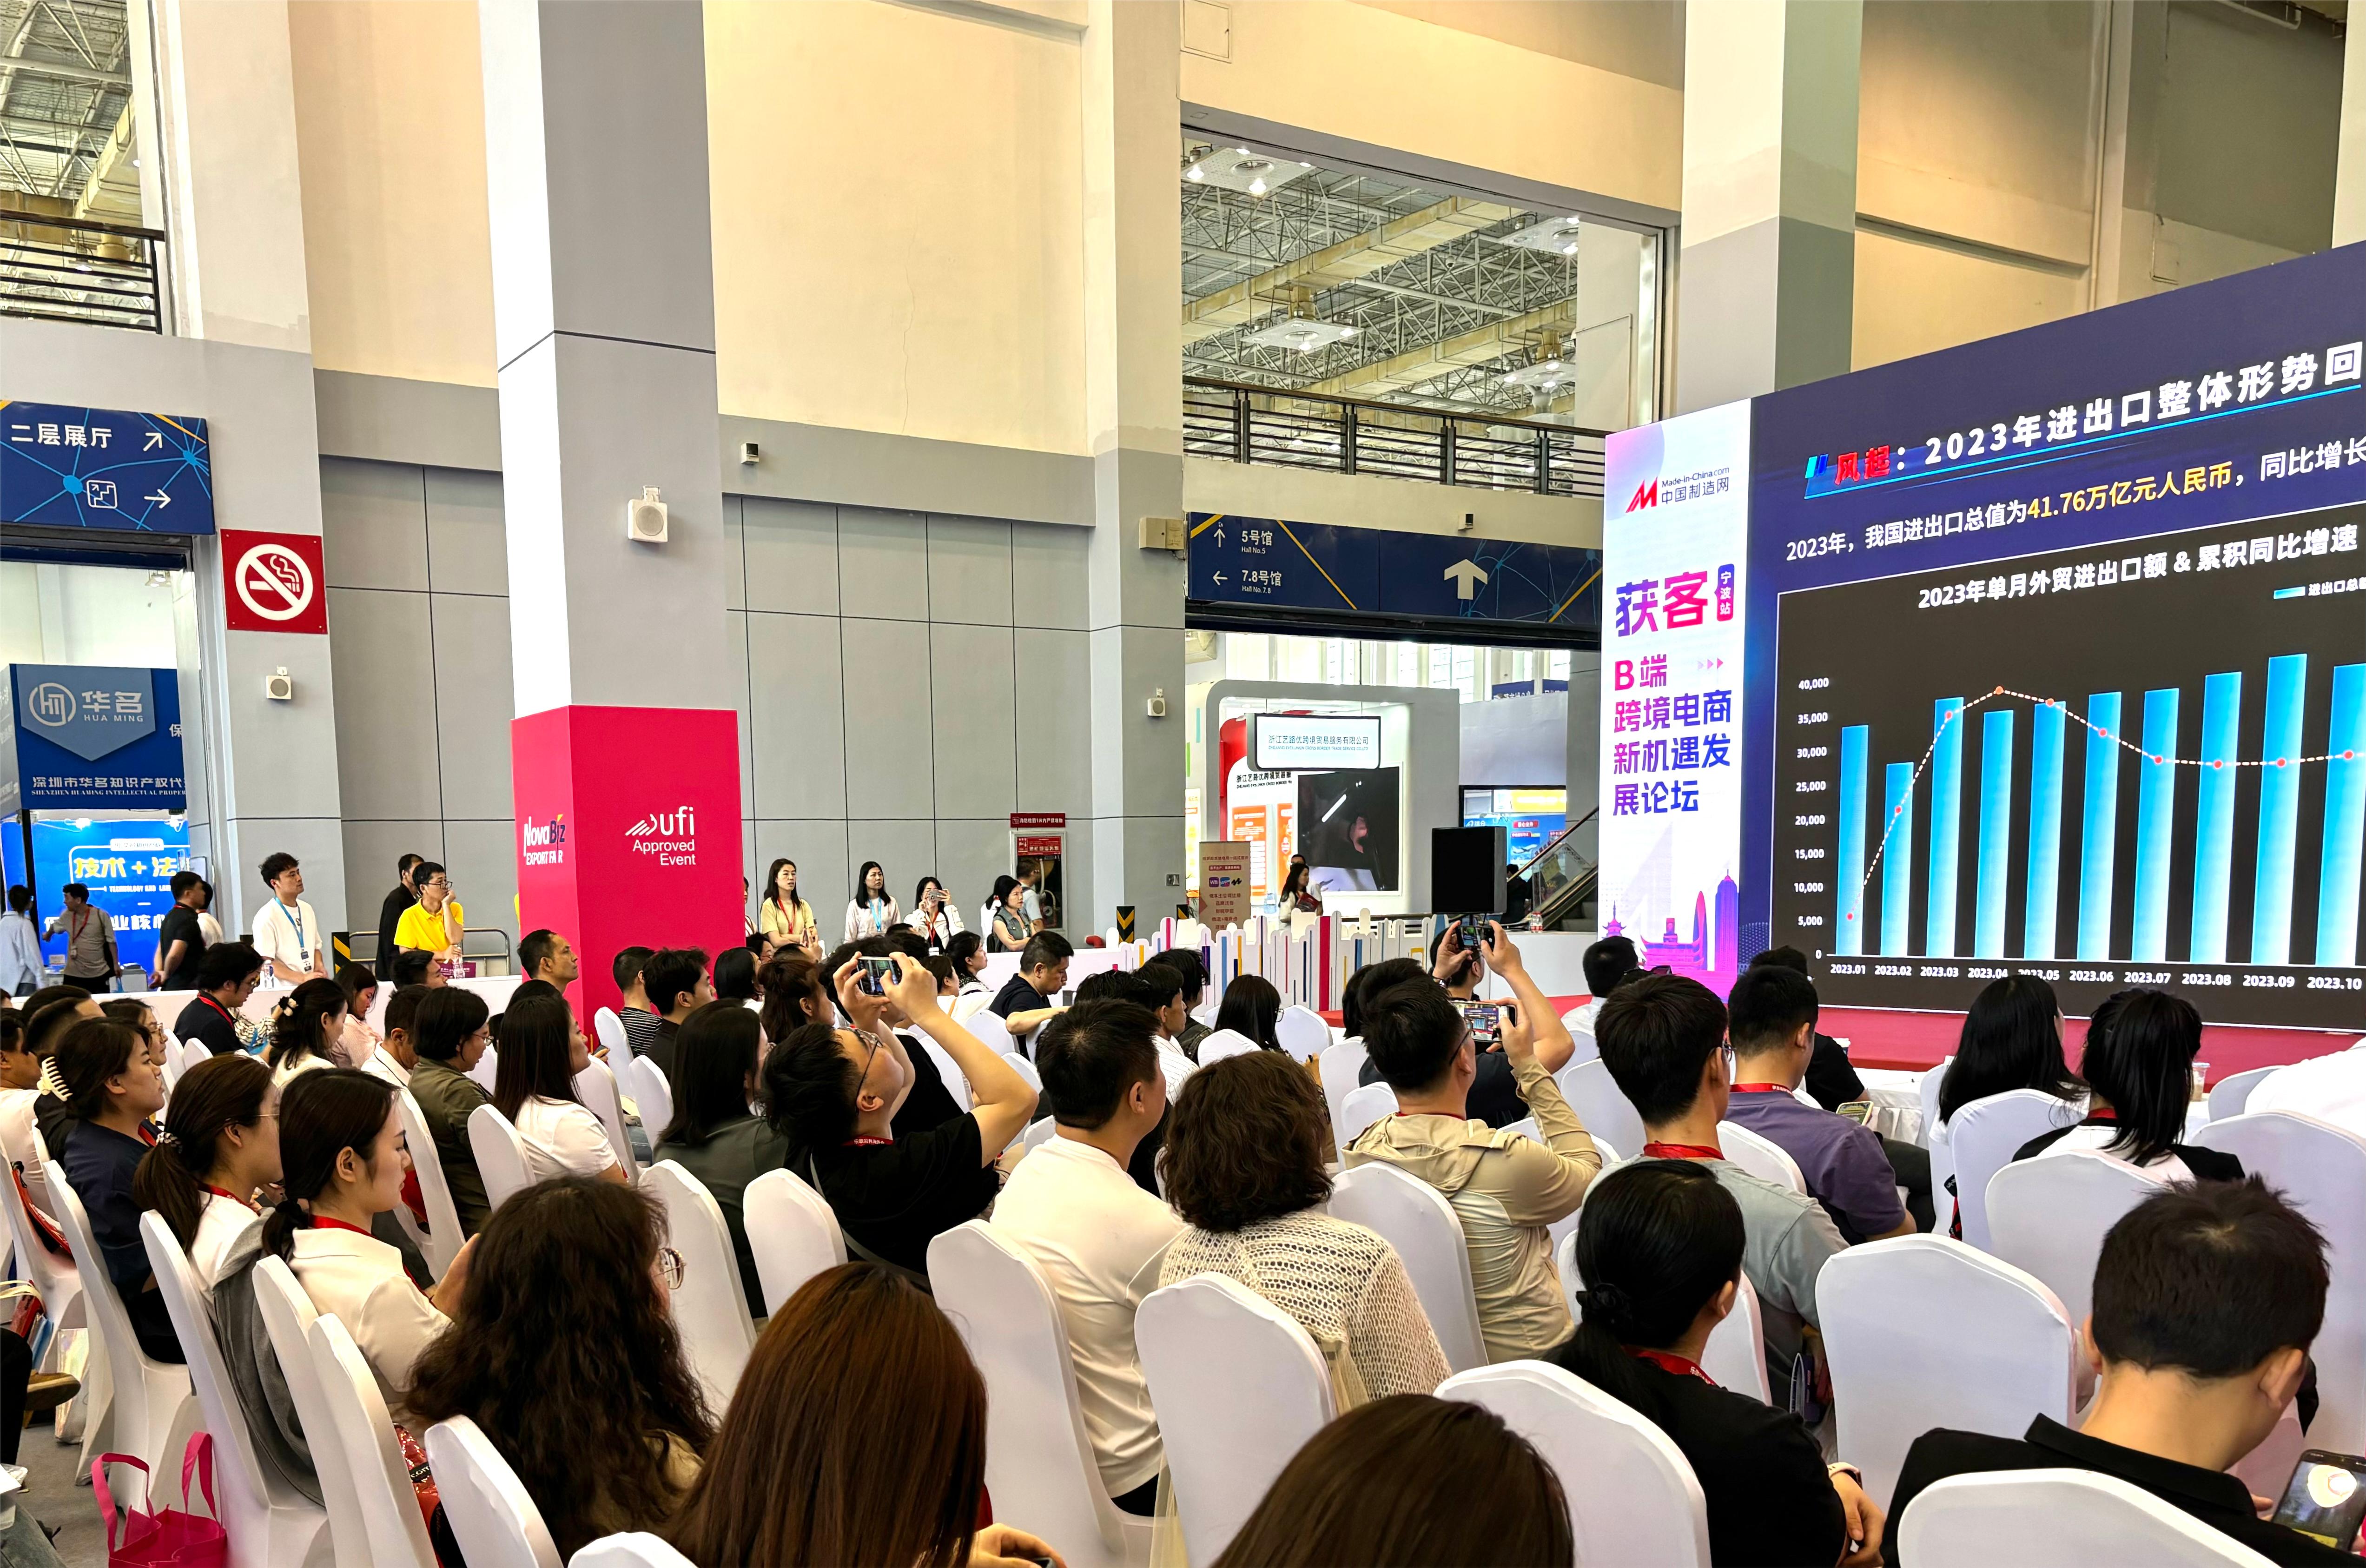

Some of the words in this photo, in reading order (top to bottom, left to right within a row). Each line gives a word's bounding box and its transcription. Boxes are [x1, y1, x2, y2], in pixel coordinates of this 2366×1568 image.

[11, 423, 112, 449] 二层展厅
[1662, 476, 1729, 504] 中国制造网
[1241, 529, 1273, 546] 5号馆
[1918, 551, 2168, 609] 2023年单月外贸进出口额
[2174, 551, 2191, 574] &
[2196, 523, 2358, 573] 累积同比增速
[1242, 569, 1282, 586] 7.8号馆
[1719, 571, 1732, 615] 宁波站
[1615, 570, 1708, 638] 获客
[1798, 677, 1830, 690] 40,000
[81, 690, 142, 714] 华名
[1613, 689, 1732, 734] 跨境电商
[1798, 712, 1828, 725] 35,000
[1613, 732, 1731, 775] 新机遇发
[1797, 746, 1827, 759] 30,000
[1796, 781, 1826, 793] 25,000
[1613, 779, 1699, 816] 展论坛
[659, 806, 694, 836] ufi
[1795, 814, 1825, 827] 20,000
[523, 814, 565, 857] NovaBiz
[633, 839, 695, 854] Approved
[1794, 848, 1824, 860] 15,000
[526, 851, 549, 866] EXPORT
[660, 853, 696, 866] Event
[73, 857, 127, 878] 技术
[1794, 882, 1824, 893] 10,000
[1798, 915, 1823, 927] 5,000
[1815, 949, 1822, 959] 0
[1830, 964, 1866, 974] 2023.01
[1874, 965, 1912, 976] 2023.02
[1920, 966, 1959, 978] 2023.03
[1968, 967, 2008, 979] 2023.04
[2069, 970, 2115, 982] 2023.06
[2124, 971, 2172, 984] 2023.07
[2181, 973, 2232, 986] 2023.08
[2242, 974, 2295, 988] 2023.09
[2307, 976, 2363, 990] 2023.10
